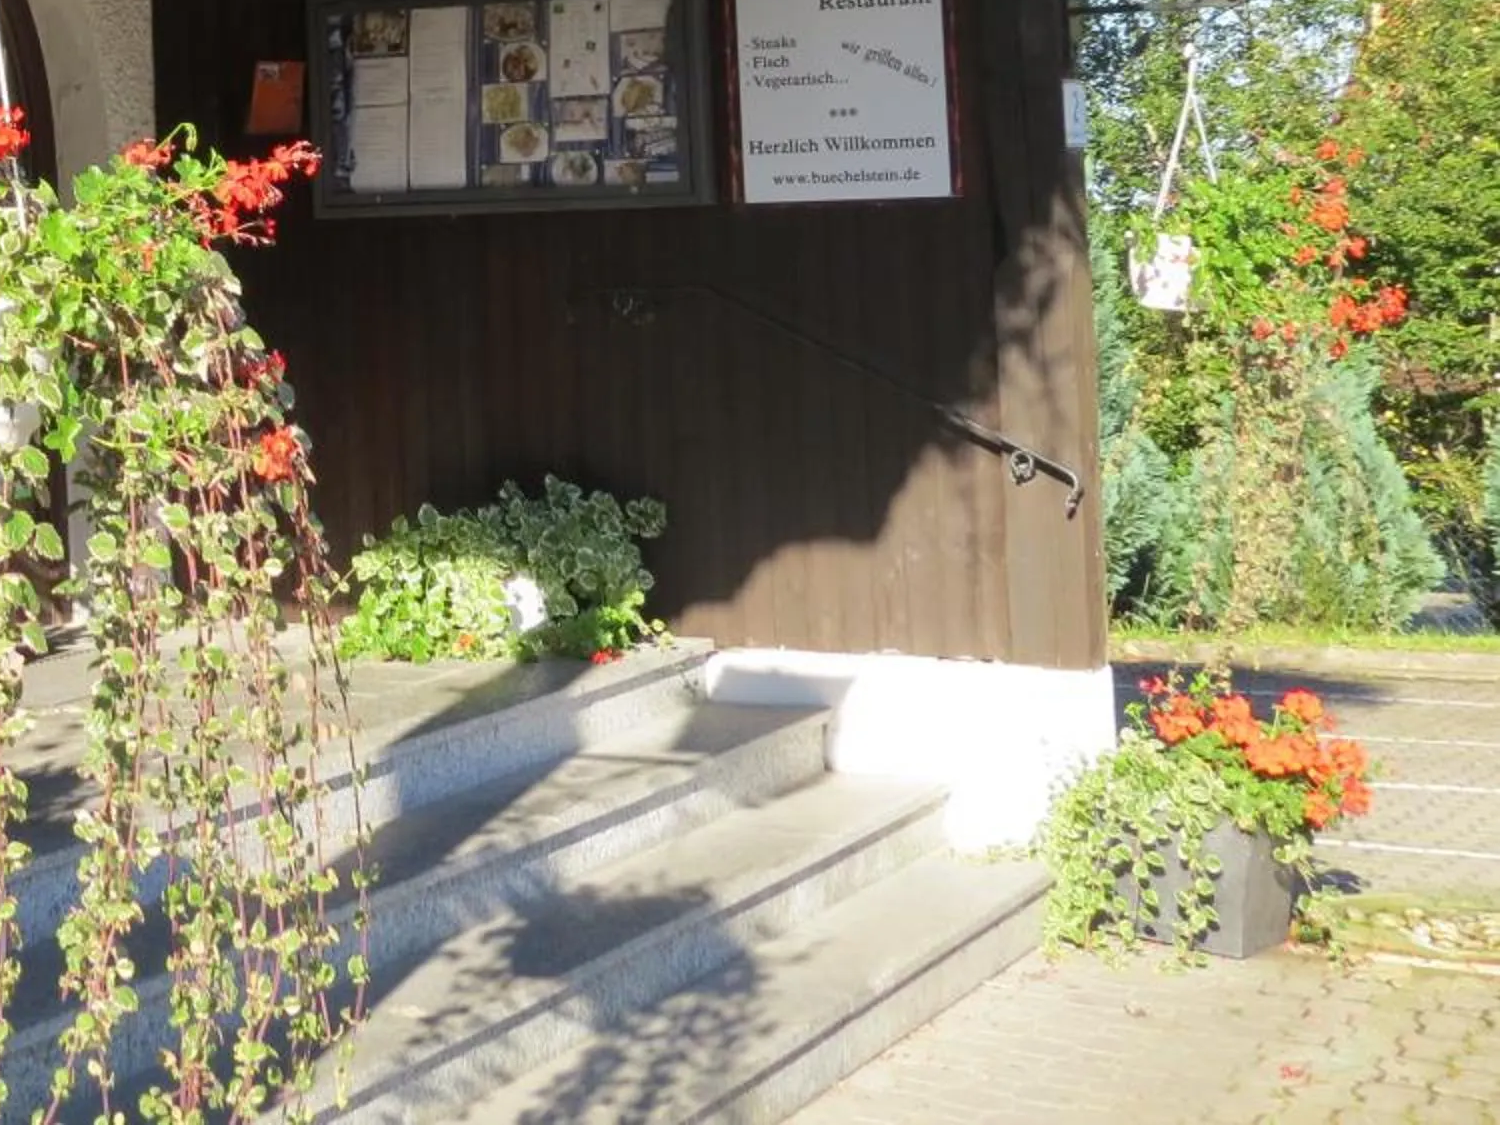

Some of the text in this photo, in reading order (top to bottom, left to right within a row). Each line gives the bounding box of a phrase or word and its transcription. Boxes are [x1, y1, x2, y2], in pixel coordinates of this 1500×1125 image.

[748, 135, 936, 155] Herzlich Willkommen
[772, 167, 921, 186] www.buechelstein.de
